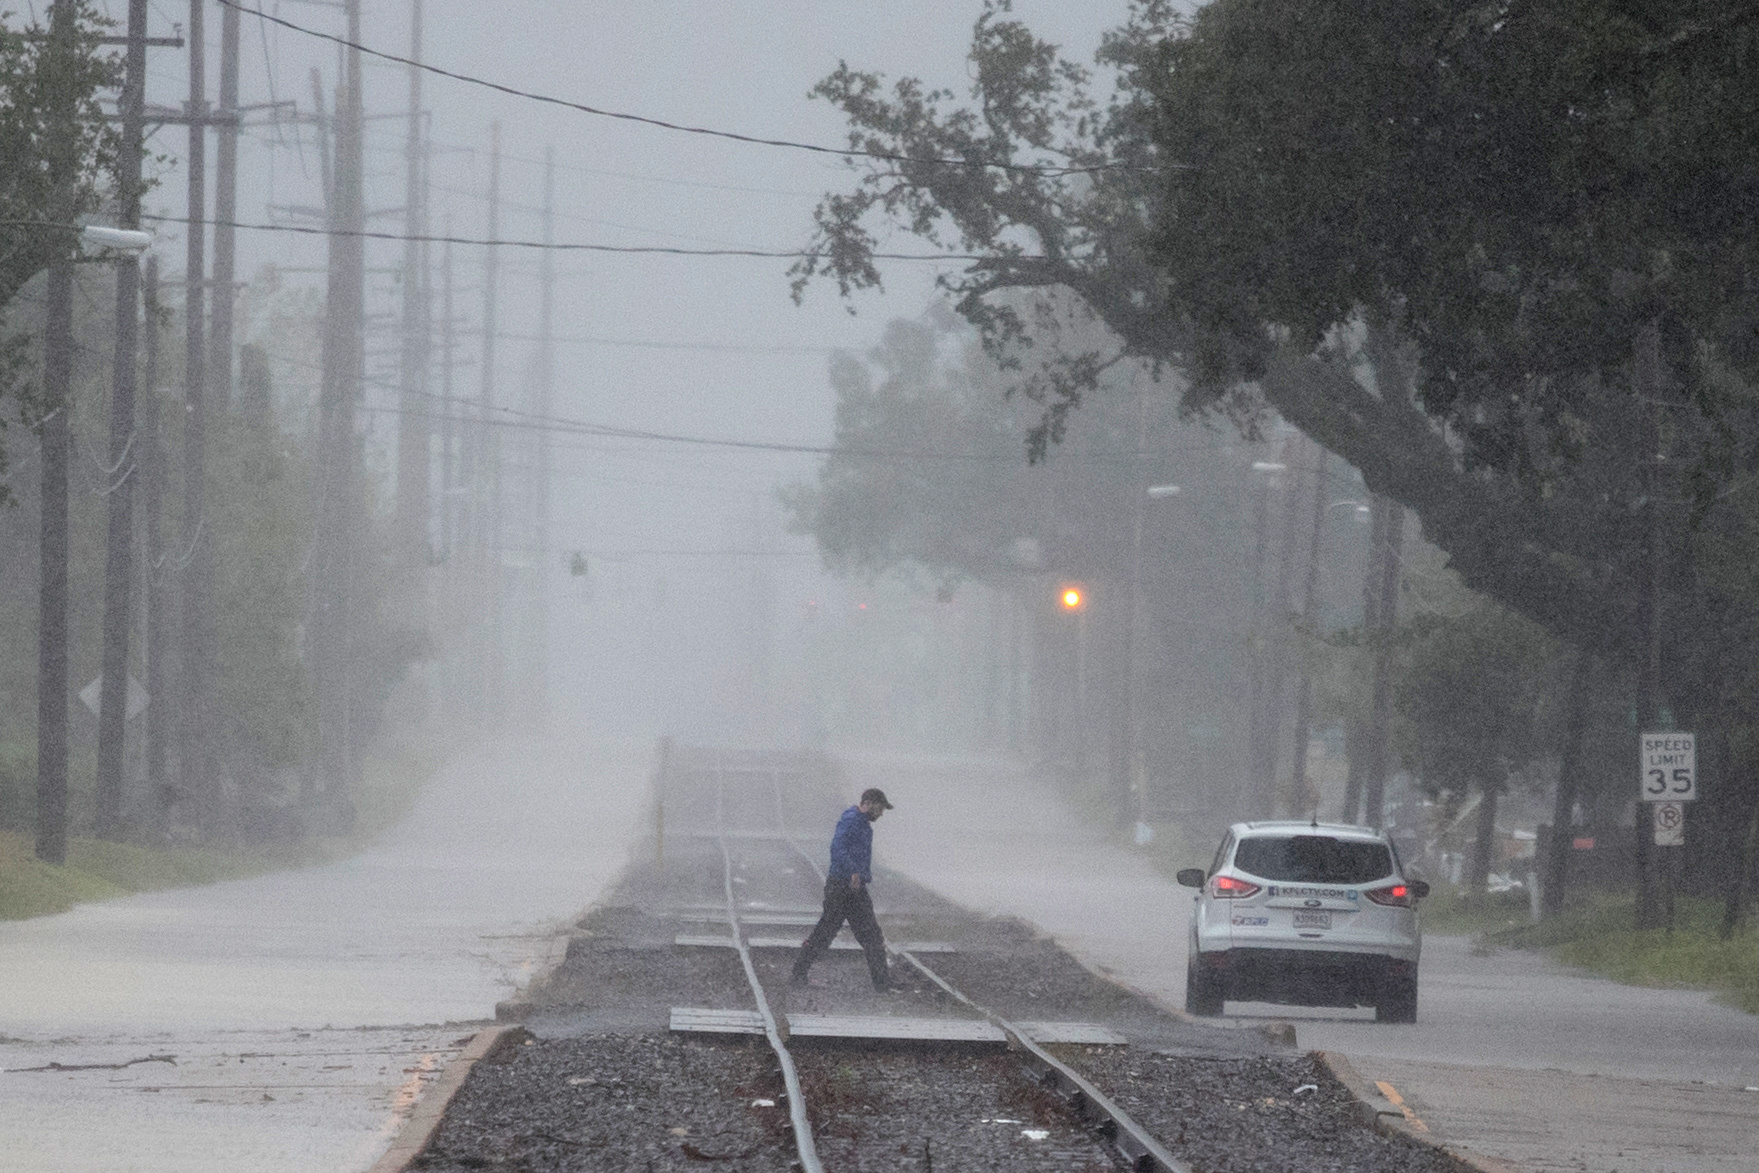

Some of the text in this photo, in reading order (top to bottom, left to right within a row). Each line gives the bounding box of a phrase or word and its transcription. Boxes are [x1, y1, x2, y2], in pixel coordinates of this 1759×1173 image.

[1646, 740, 1691, 751] SPEED
[1651, 755, 1686, 765] LIMIT
[1647, 769, 1691, 794] 35
